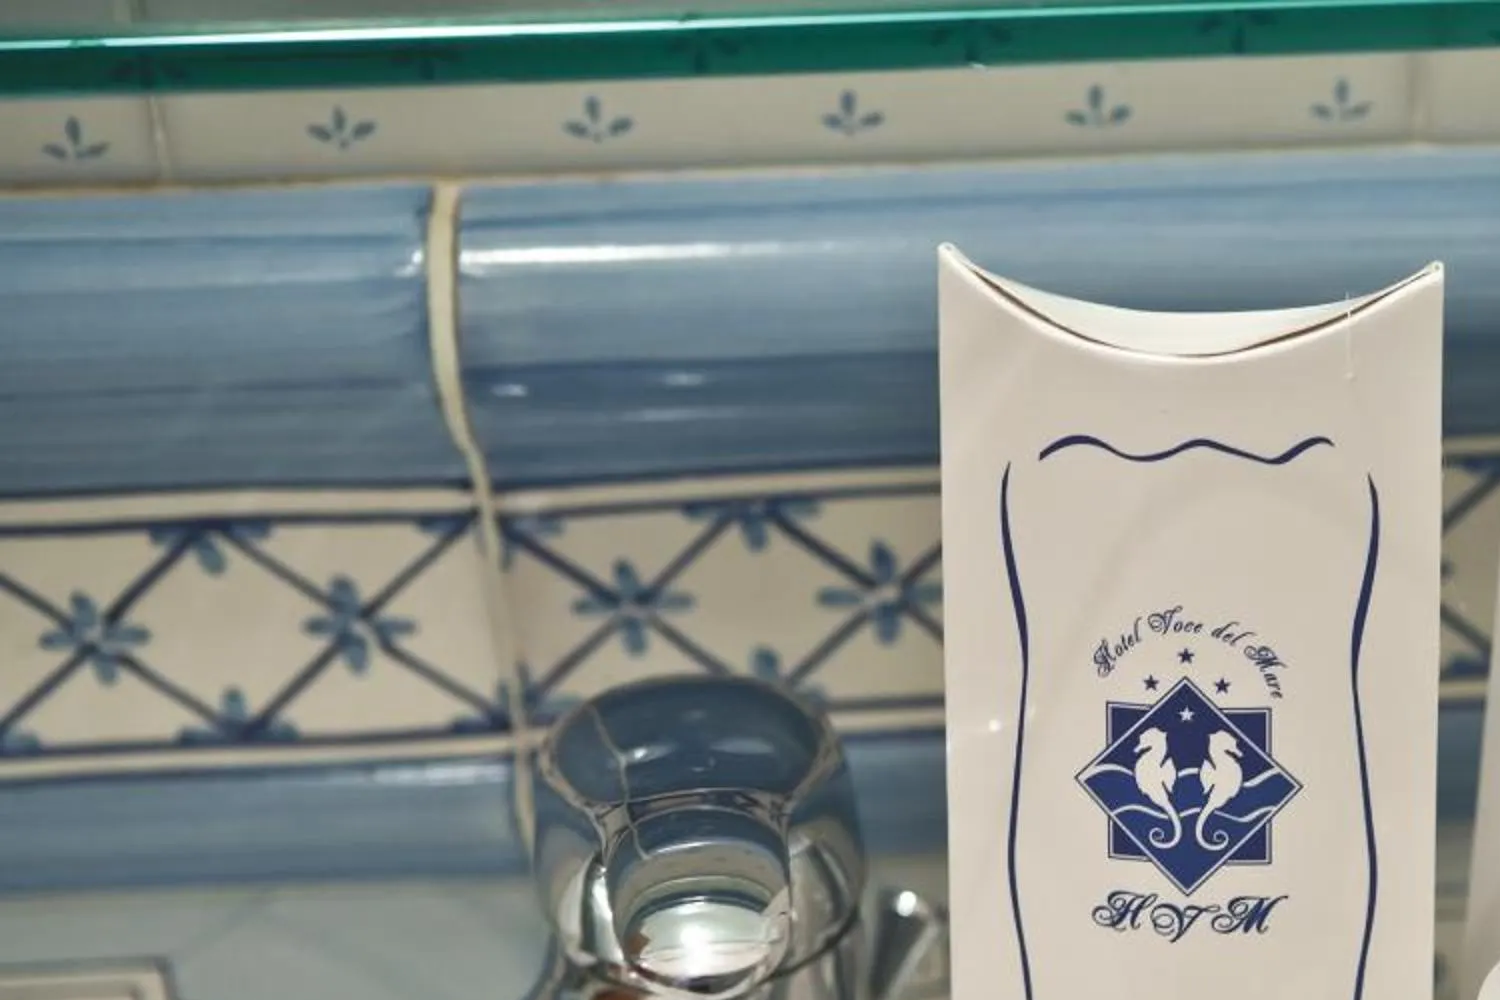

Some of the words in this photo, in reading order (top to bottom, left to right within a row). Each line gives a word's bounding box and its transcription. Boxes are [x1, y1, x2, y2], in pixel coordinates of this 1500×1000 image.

[1093, 616, 1143, 679] Hotel
[1211, 621, 1256, 647] del
[1244, 644, 1288, 700] Mare
